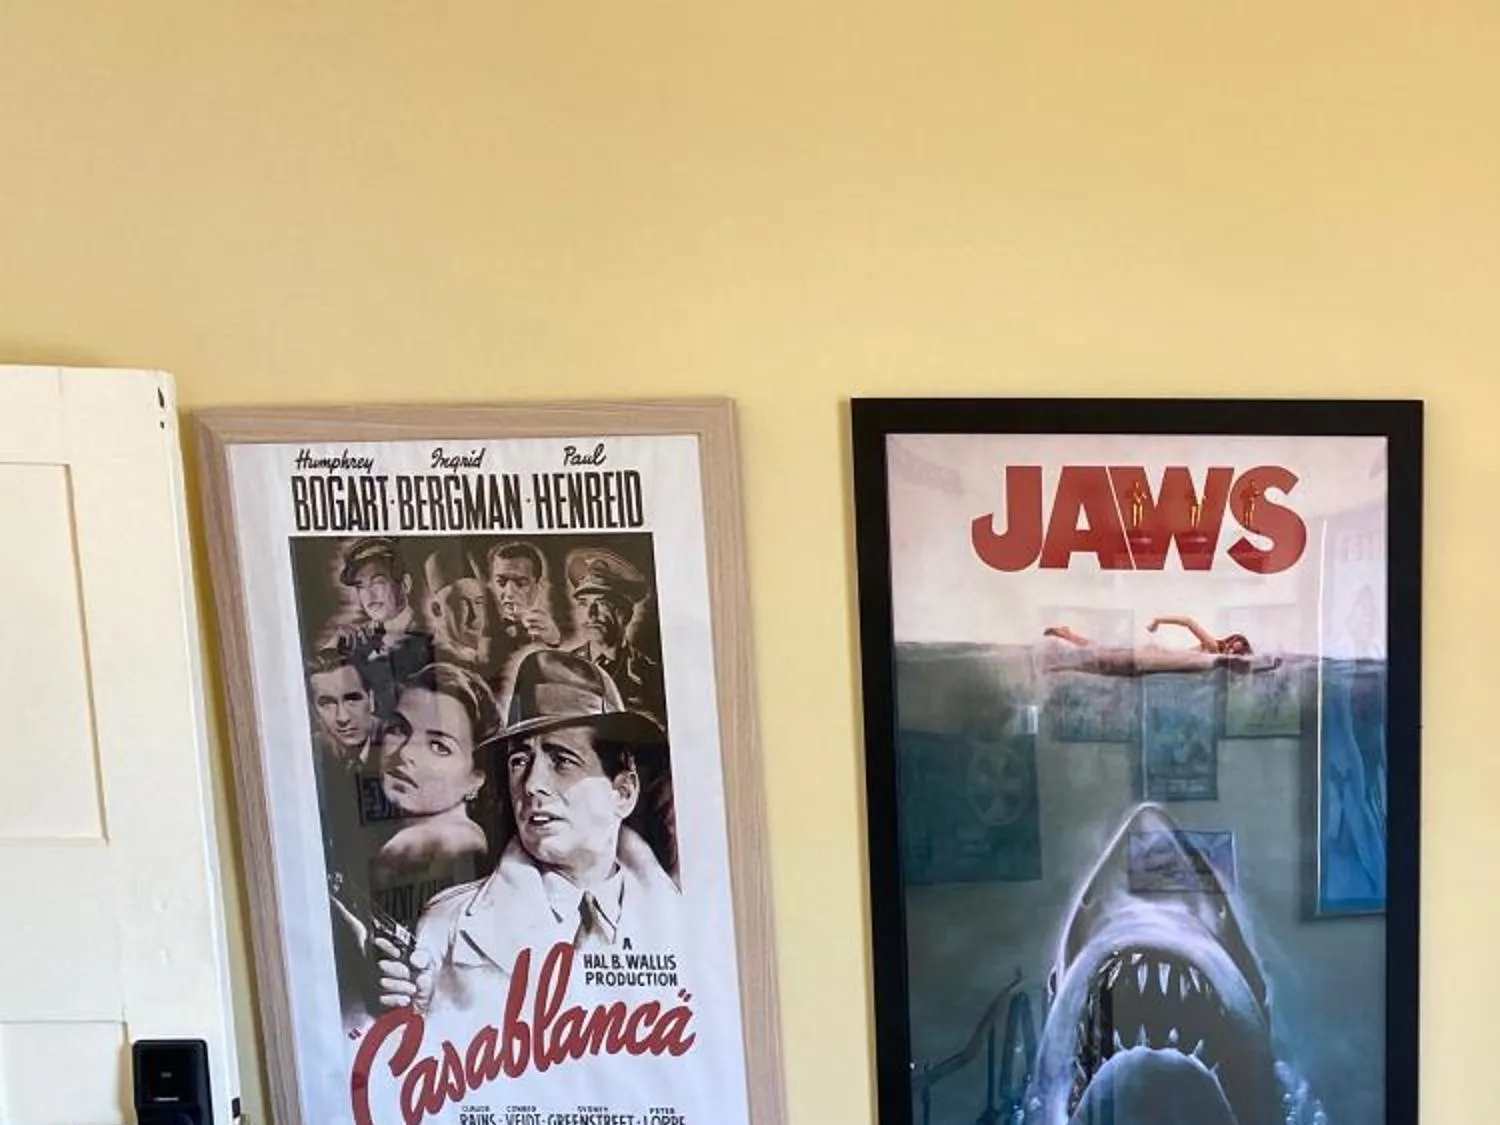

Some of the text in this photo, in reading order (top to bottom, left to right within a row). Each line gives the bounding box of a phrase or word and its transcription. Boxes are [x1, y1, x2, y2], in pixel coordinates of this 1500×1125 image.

[294, 443, 607, 474] Humphrey Ingrid Paul
[291, 470, 644, 531] BOGART BERGMAN HENREID
[970, 464, 1308, 576] JAWS
[622, 937, 632, 950] A
[583, 953, 677, 971] HAL B. WALLIS
[585, 971, 678, 987] PRODUCTION
